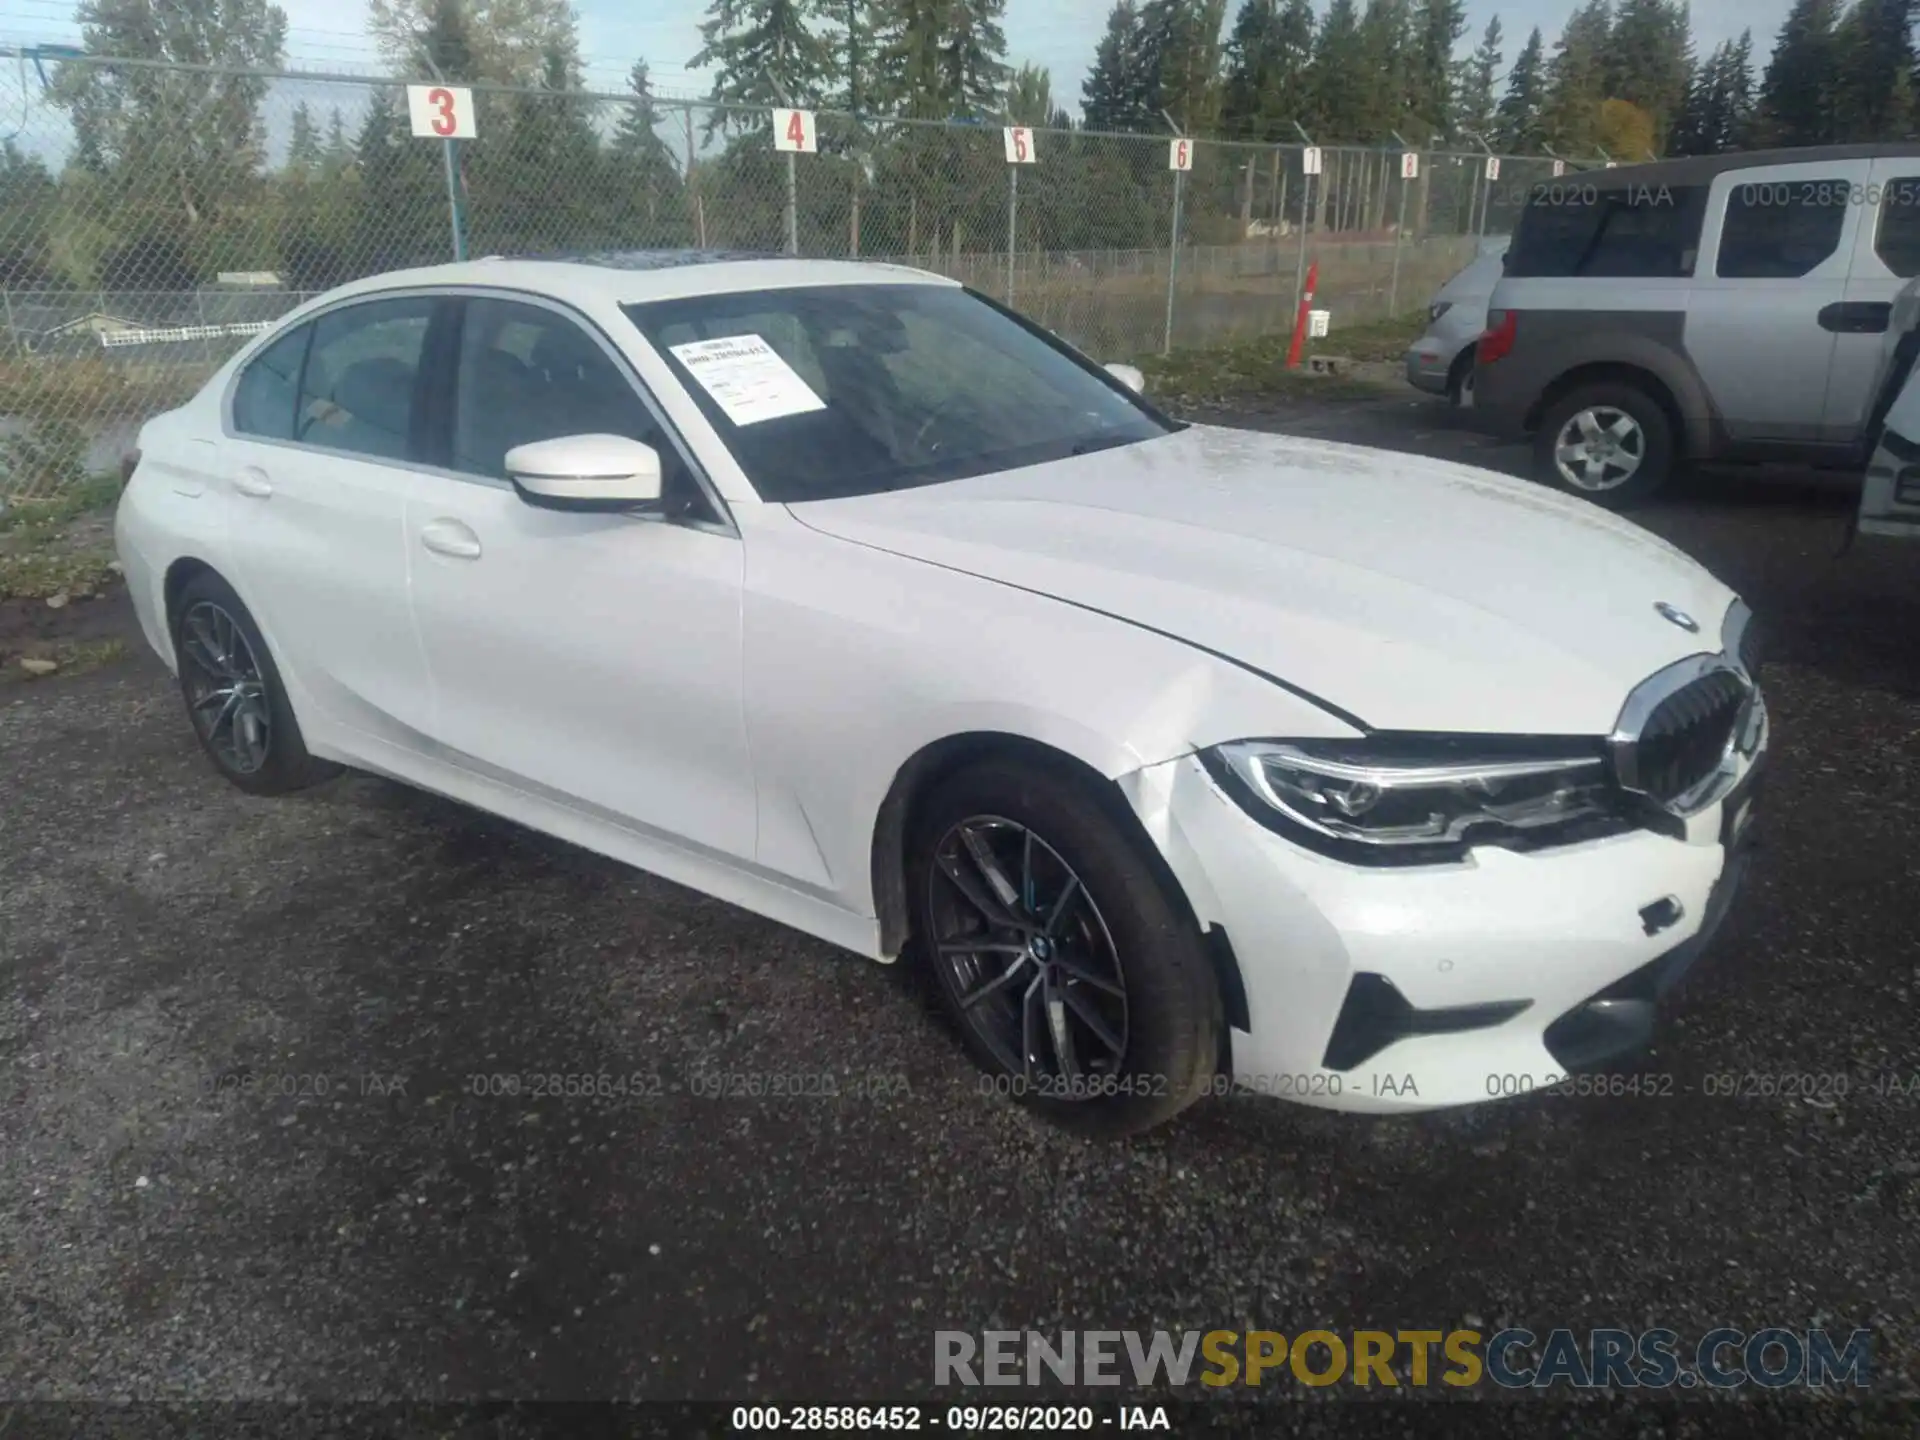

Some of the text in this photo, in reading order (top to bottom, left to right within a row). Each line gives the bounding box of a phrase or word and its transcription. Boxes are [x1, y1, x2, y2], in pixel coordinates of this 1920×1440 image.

[429, 87, 457, 137] 3
[786, 111, 805, 150] 4
[1013, 128, 1027, 161] 5
[1178, 140, 1187, 169] 6
